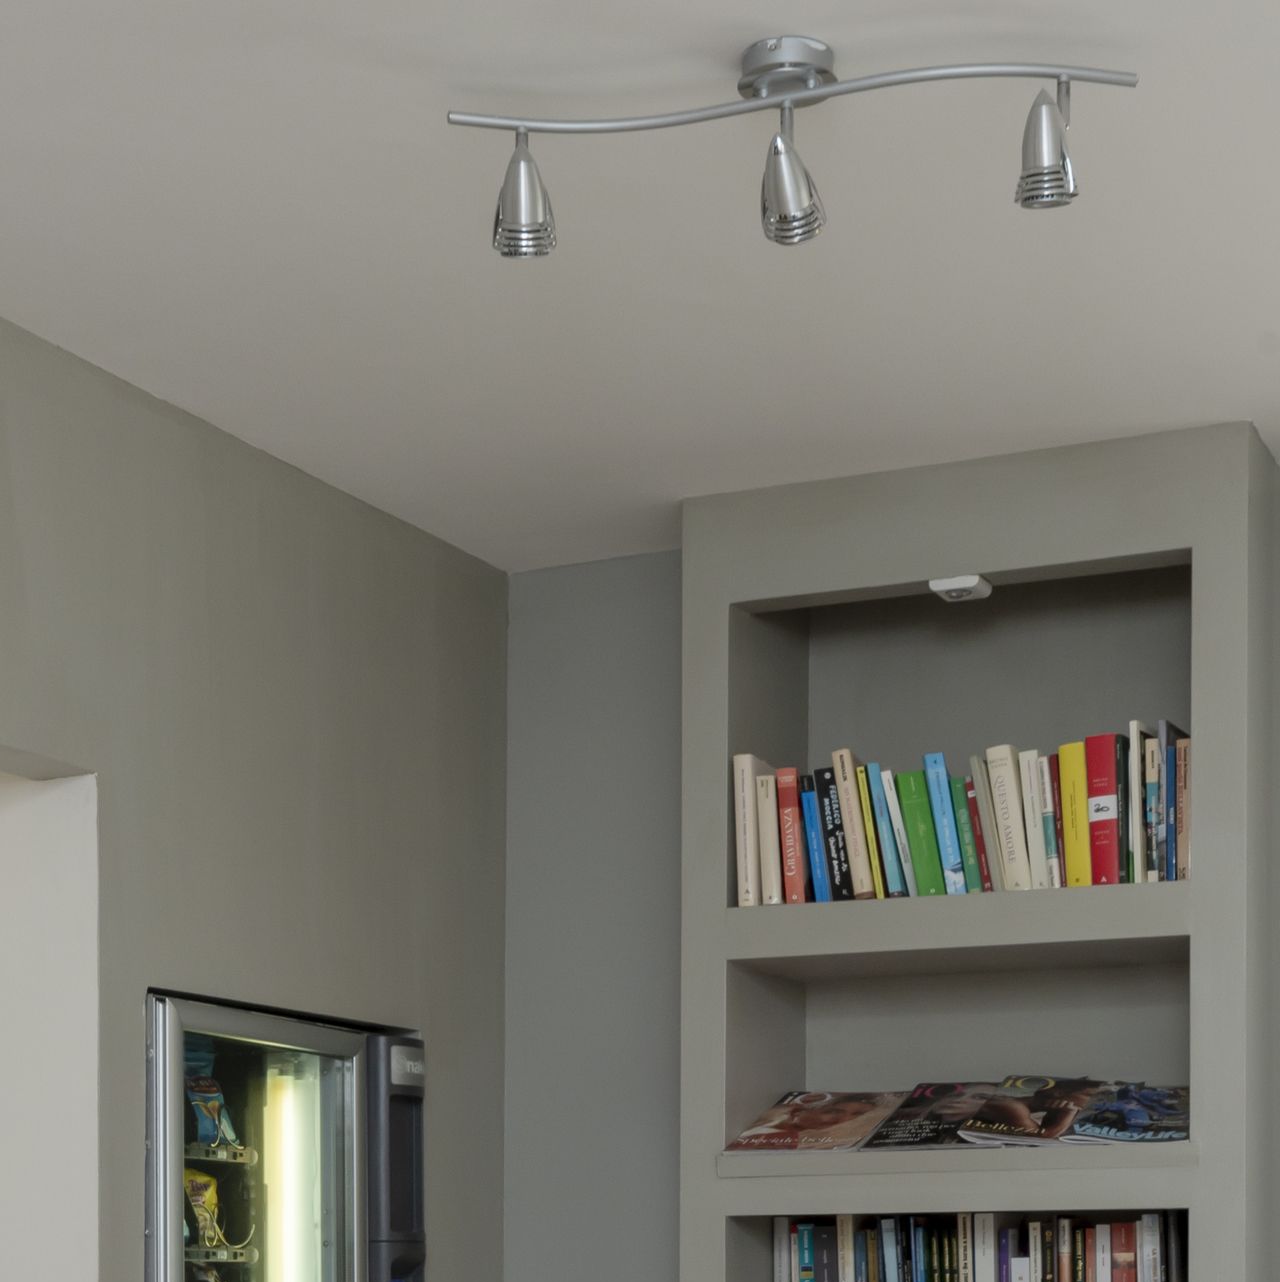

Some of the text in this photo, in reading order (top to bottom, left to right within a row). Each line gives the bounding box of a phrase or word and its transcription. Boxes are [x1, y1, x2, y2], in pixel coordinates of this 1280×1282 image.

[824, 798, 832, 830] MOCCIA
[828, 785, 840, 824] FEDERICO
[995, 776, 1010, 821] QUESTO
[1003, 823, 1016, 864] AMORE
